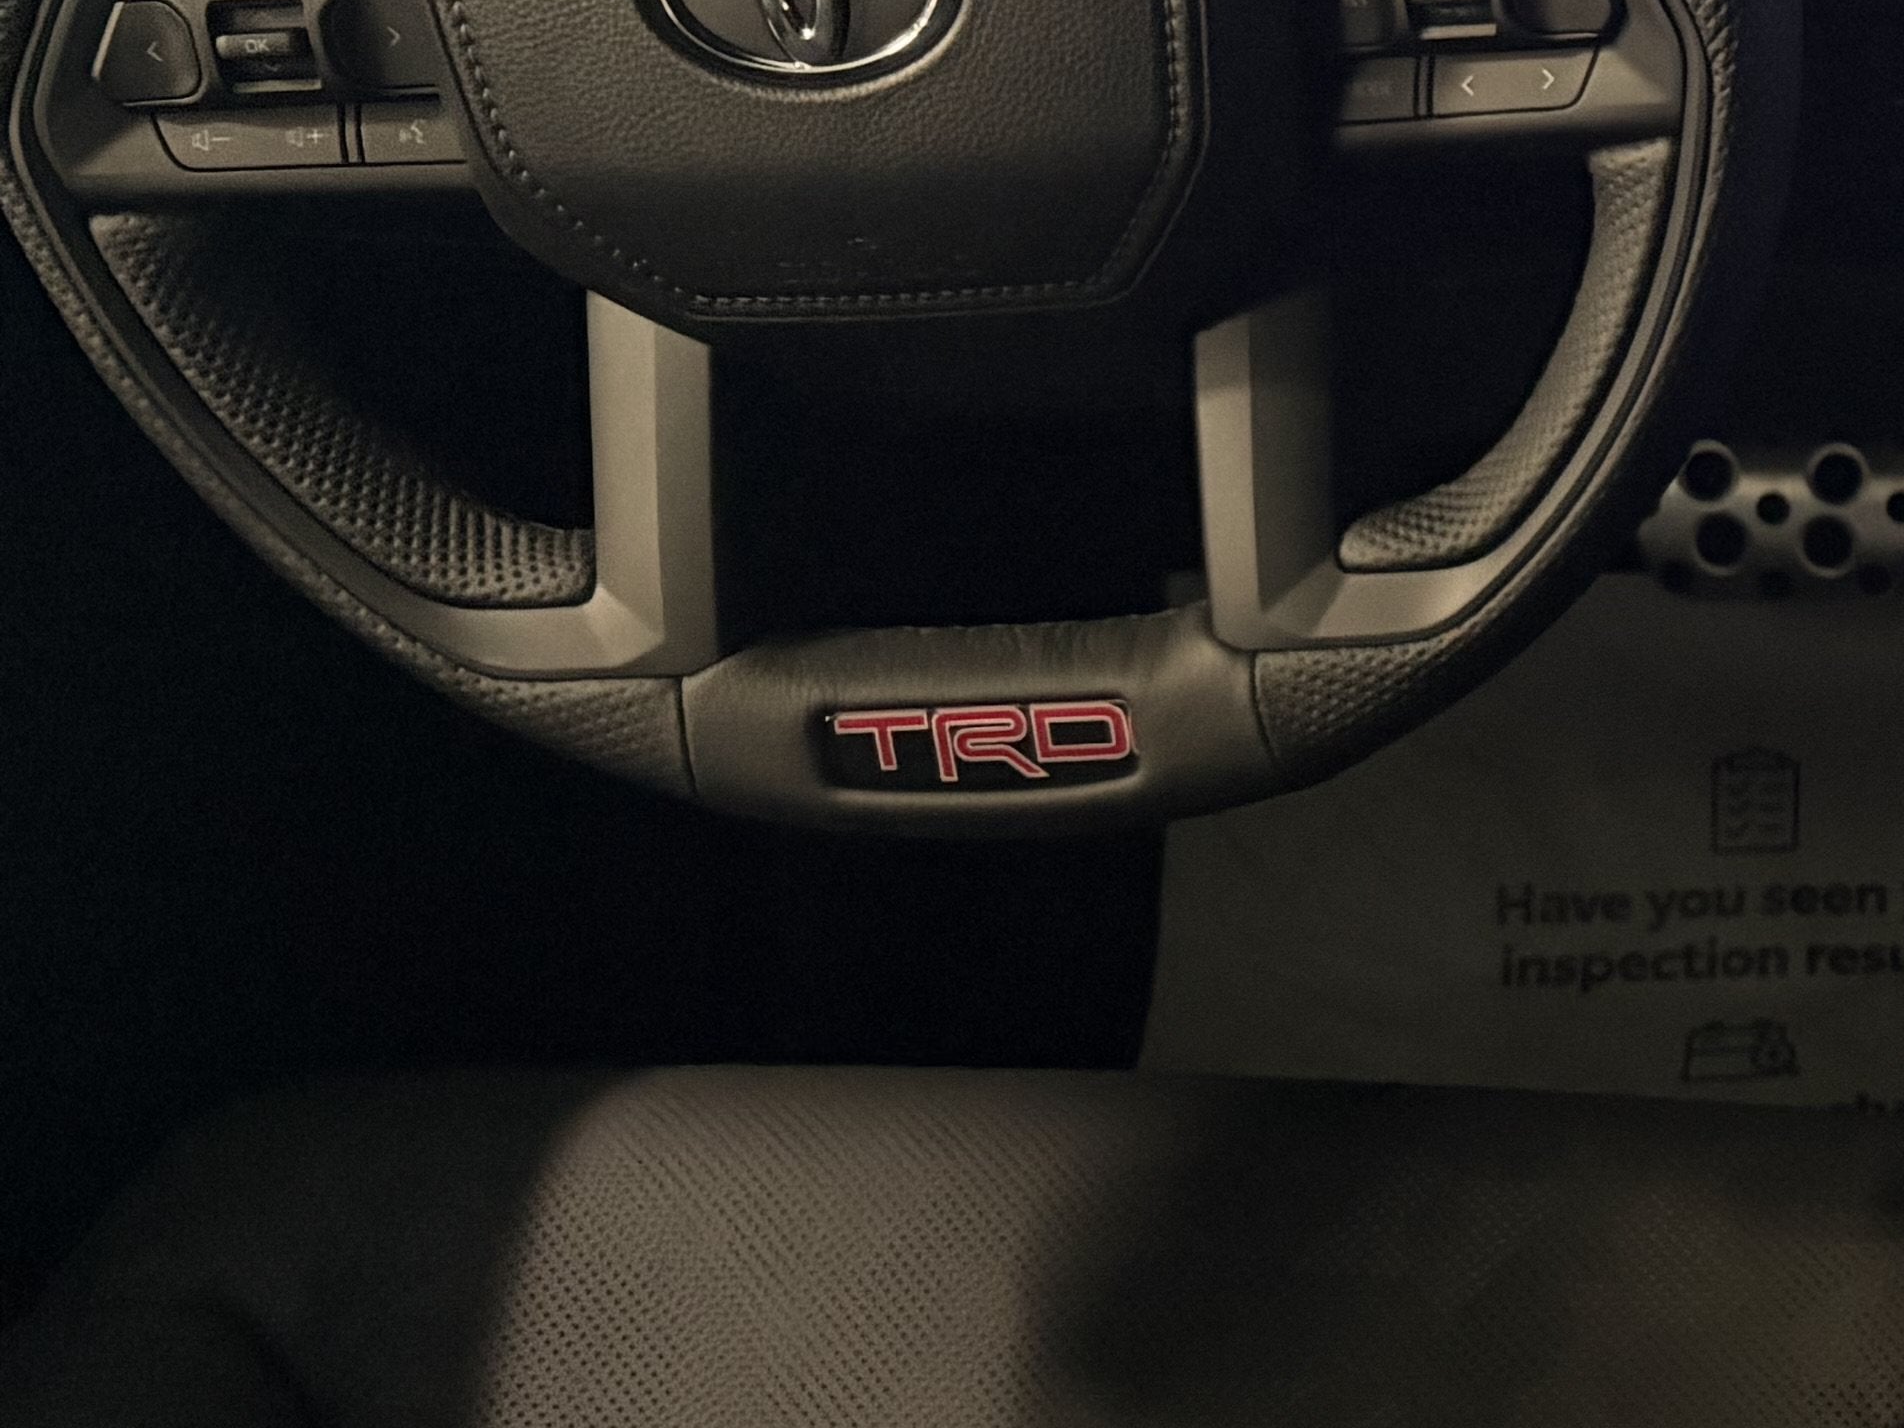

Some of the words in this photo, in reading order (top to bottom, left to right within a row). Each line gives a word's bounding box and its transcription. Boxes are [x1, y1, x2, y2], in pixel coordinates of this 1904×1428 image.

[245, 38, 271, 53] OK
[833, 700, 1132, 784] TRD
[1498, 881, 1634, 925] Have
[1645, 887, 1747, 933] you
[1759, 882, 1888, 917] seen
[1501, 936, 1792, 993] inspection
